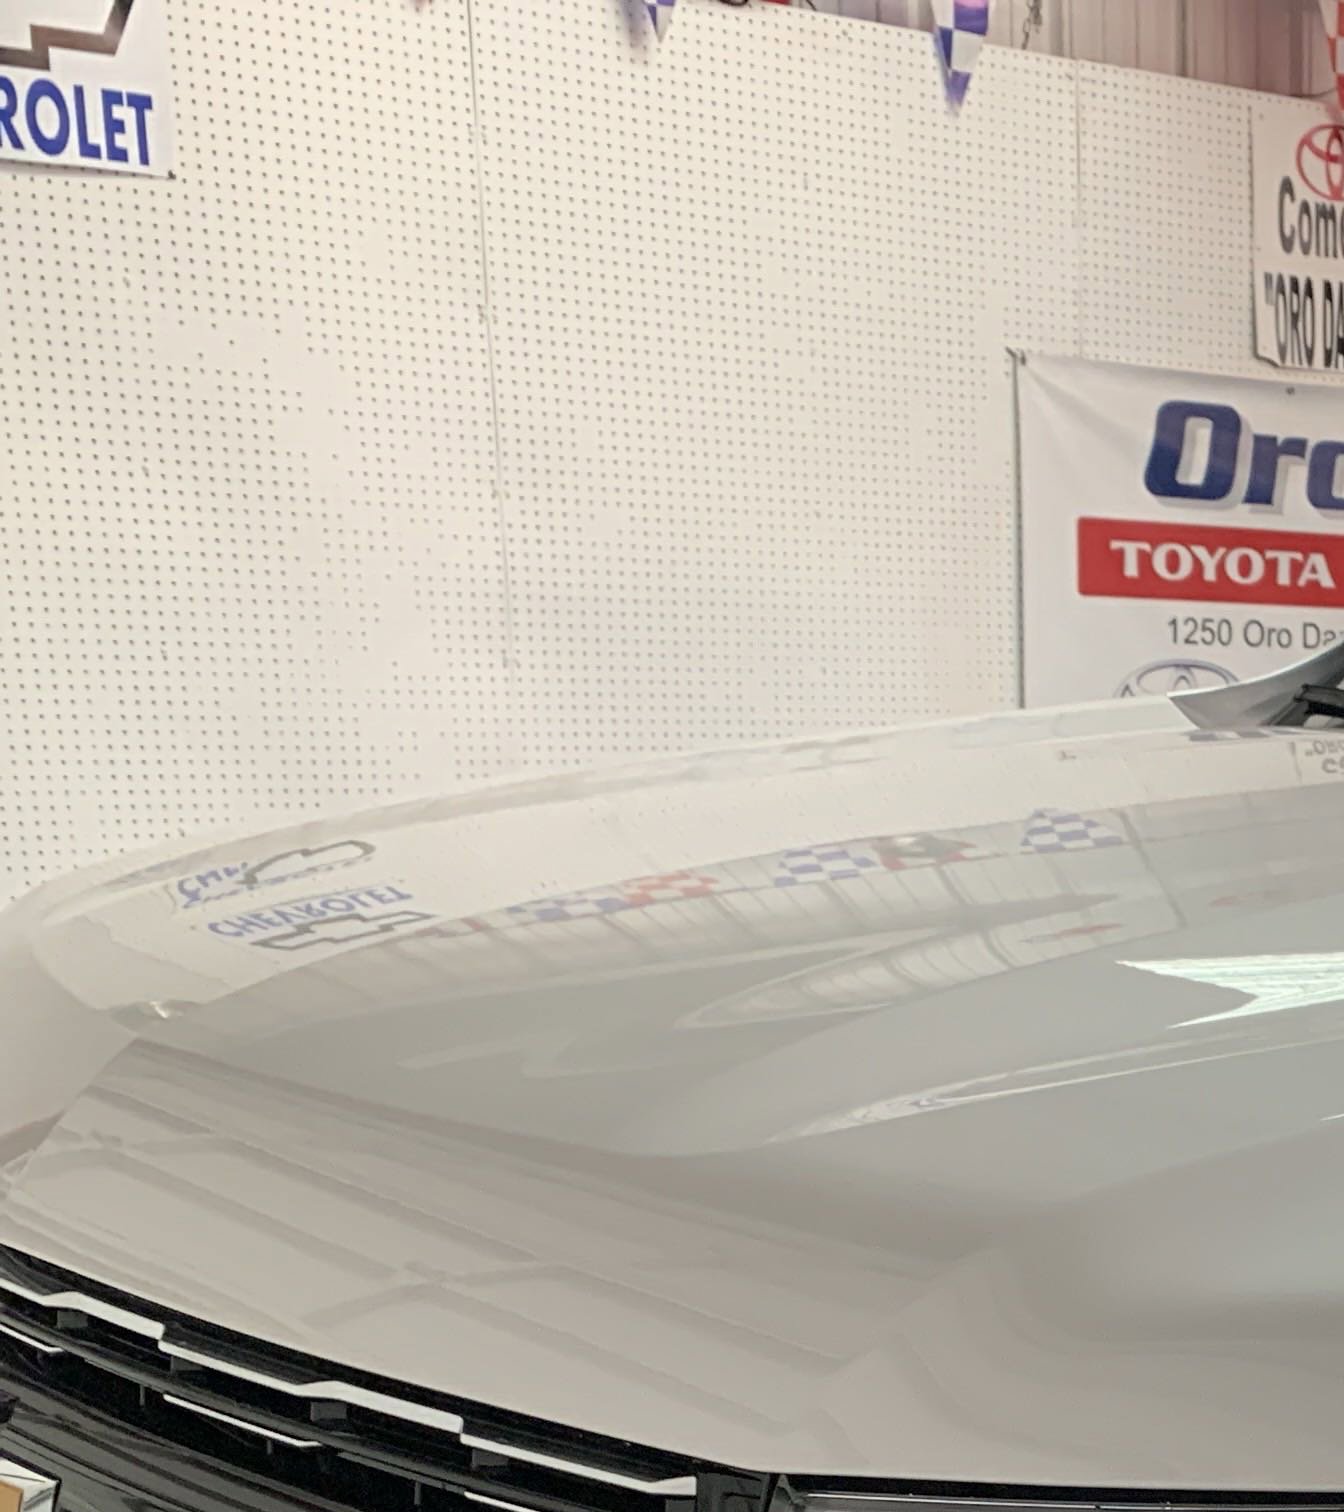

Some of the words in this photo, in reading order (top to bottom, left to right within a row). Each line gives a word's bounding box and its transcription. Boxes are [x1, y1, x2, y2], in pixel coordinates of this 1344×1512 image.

[1264, 271, 1316, 367] "ORO
[1109, 538, 1336, 590] TOYOTA
[1167, 617, 1233, 648] 1250
[1243, 619, 1293, 649] Oro
